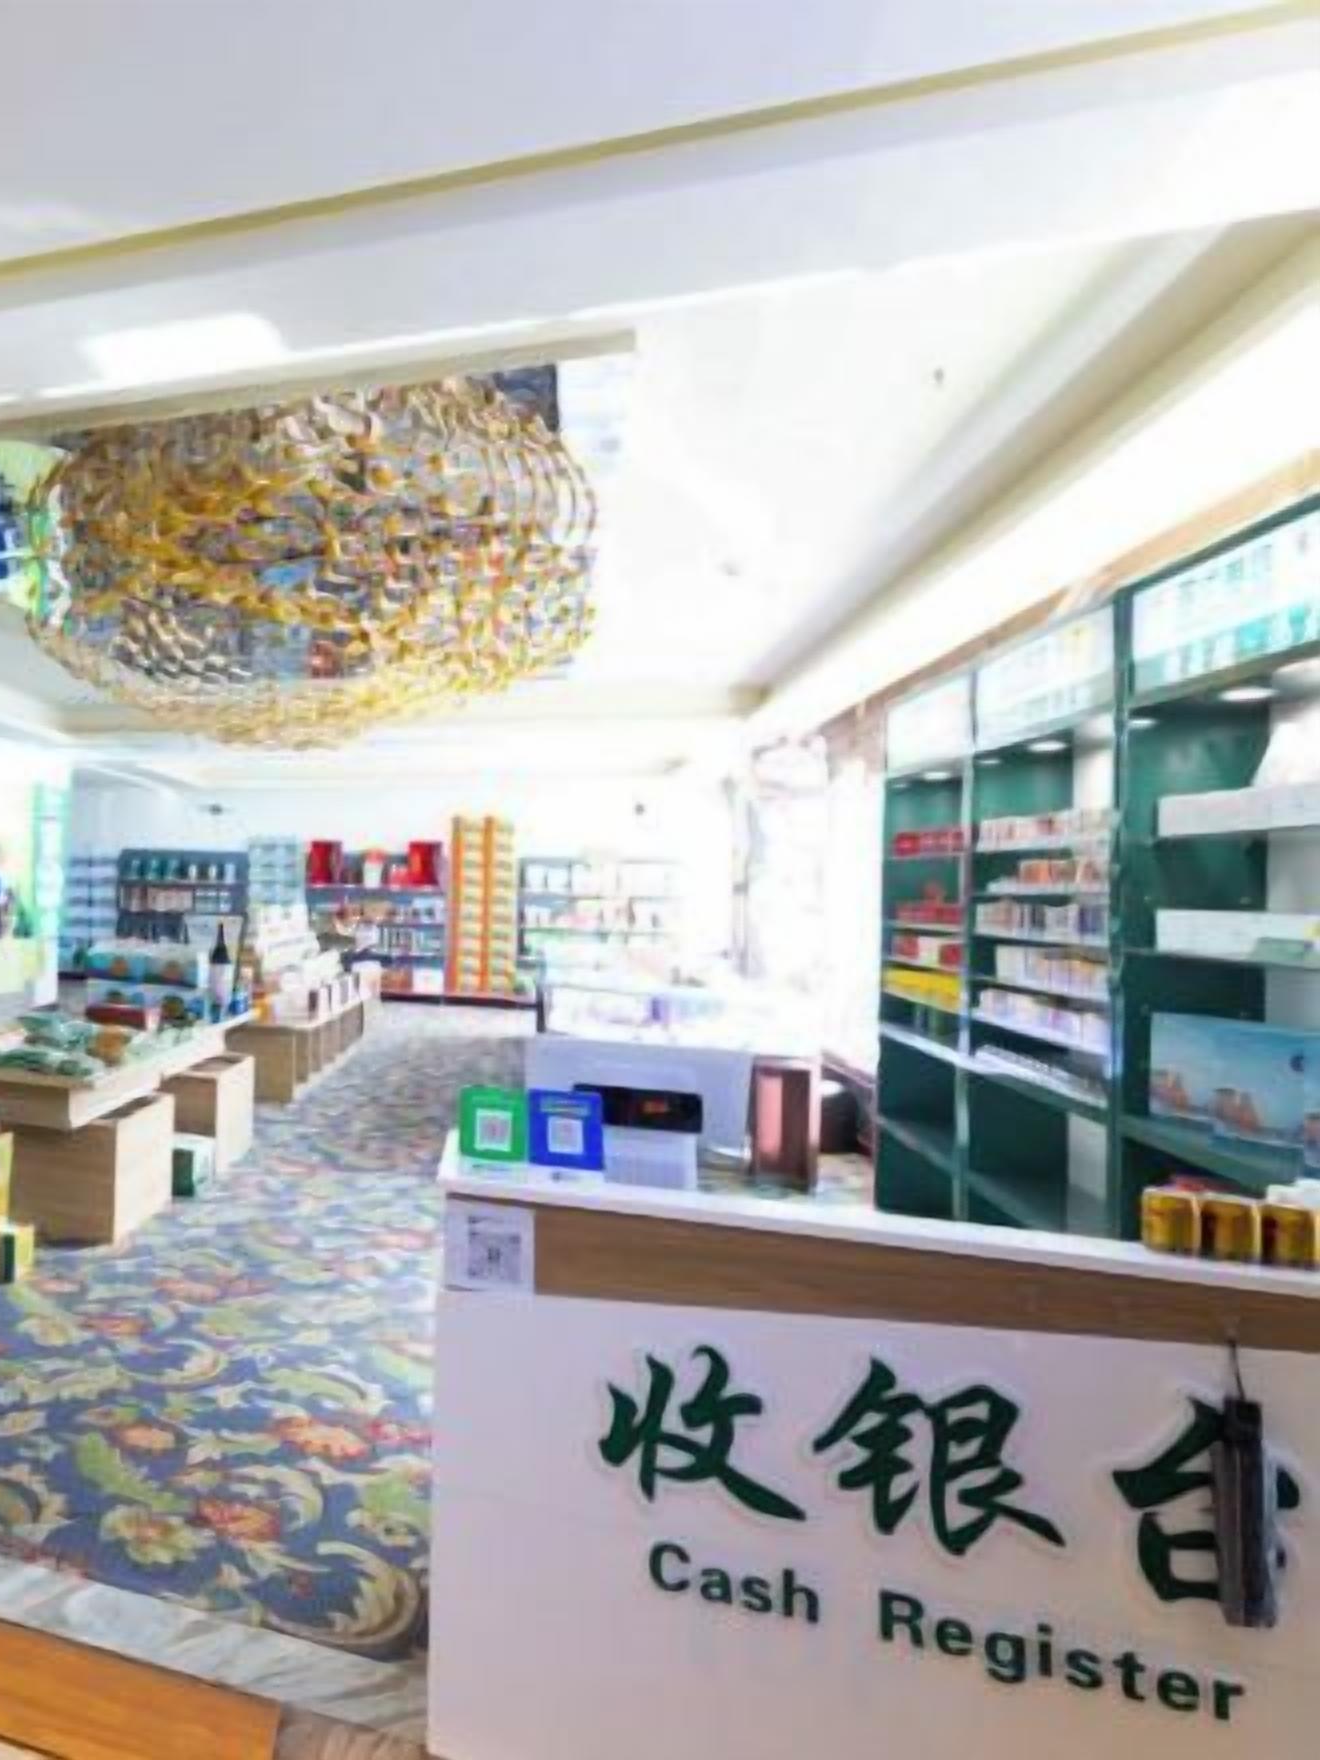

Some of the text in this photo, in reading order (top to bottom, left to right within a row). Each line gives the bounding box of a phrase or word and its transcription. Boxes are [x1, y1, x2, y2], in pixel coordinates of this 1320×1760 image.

[597, 1343, 1302, 1605] 收银台
[648, 1542, 1245, 1722] Cash Register
